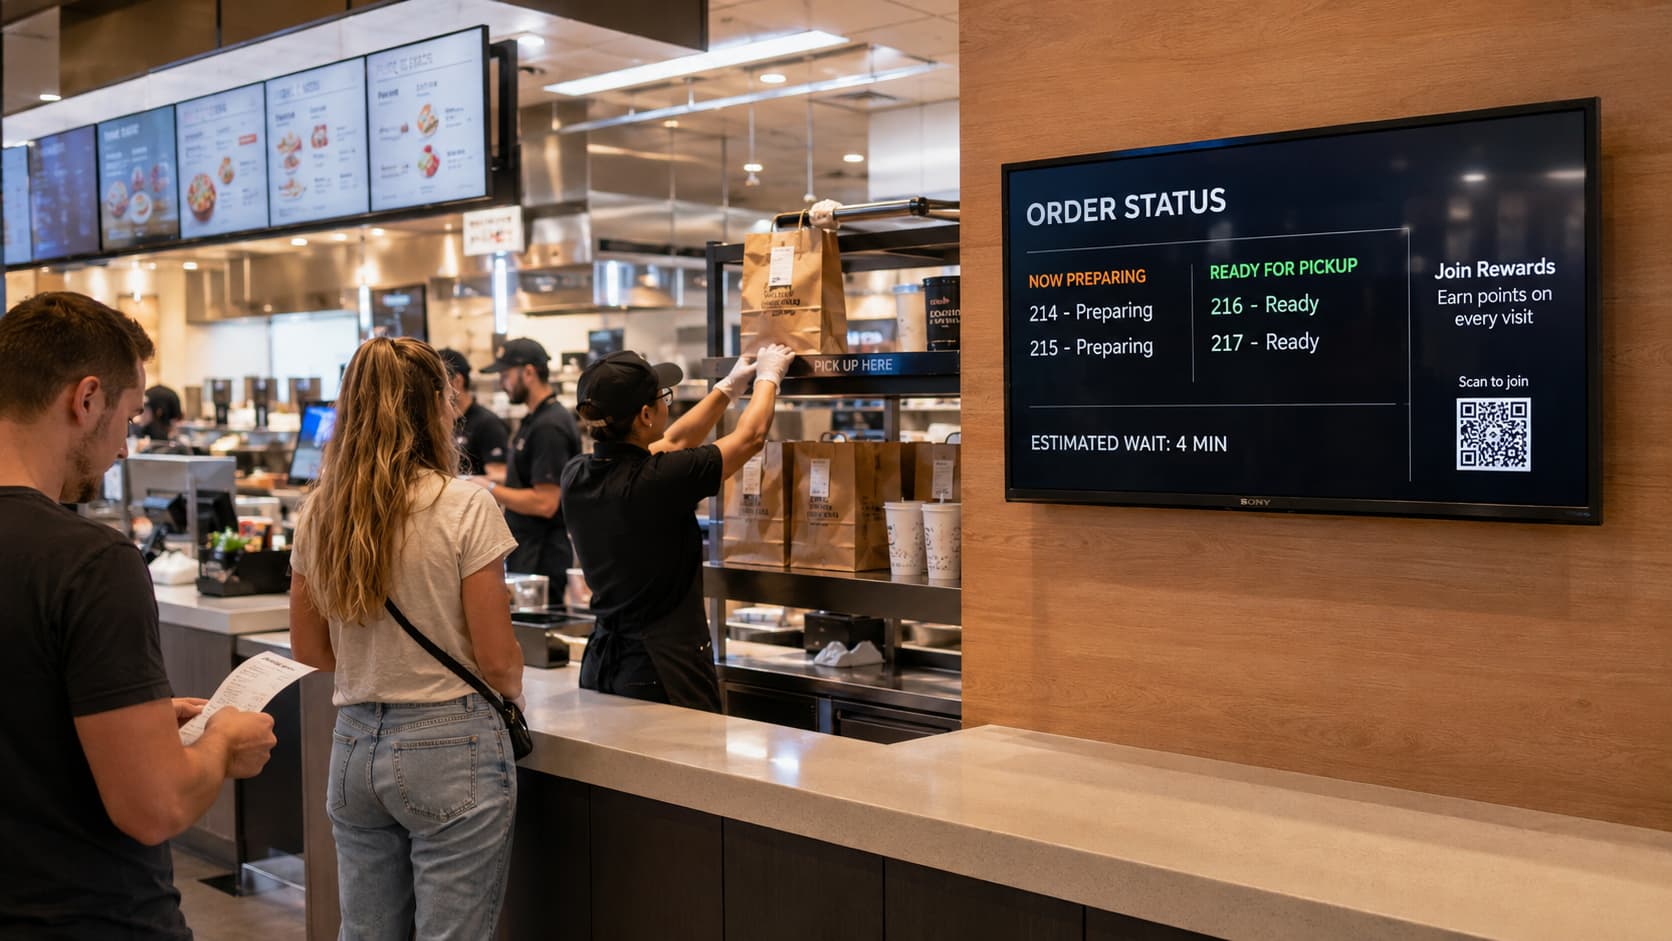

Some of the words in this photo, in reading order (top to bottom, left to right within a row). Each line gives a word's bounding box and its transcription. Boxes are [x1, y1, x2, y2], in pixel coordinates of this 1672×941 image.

[1027, 197, 1117, 226] ORDER
[1125, 188, 1226, 218] STATUS
[1030, 274, 1063, 288] NOW
[1067, 269, 1146, 286] PREPARING
[1211, 263, 1259, 279] READY
[1265, 261, 1294, 276] FOR
[1300, 258, 1357, 275] PICKUP
[1435, 262, 1471, 279] Join
[1477, 257, 1555, 277] Rewards
[1211, 297, 1242, 315] 216
[1266, 294, 1319, 316] Ready
[1438, 290, 1472, 304] Earn
[1478, 286, 1527, 307] points
[1532, 289, 1552, 301] on
[1030, 305, 1057, 321] 214
[1077, 302, 1152, 323] Preparing
[1455, 314, 1497, 329] every
[1502, 309, 1533, 324] visit
[1031, 340, 1058, 356] 215
[1077, 337, 1153, 358] Preparing
[1212, 334, 1243, 351] 217
[1267, 332, 1319, 353] Ready
[814, 359, 840, 373] PICK
[843, 359, 859, 372] UP
[862, 358, 893, 372] HERE
[1459, 376, 1487, 387] Scan
[1491, 376, 1503, 387] to
[1505, 375, 1528, 390] join
[1032, 435, 1118, 450] ESTIMATED
[1124, 436, 1170, 451] WAIT:
[1175, 436, 1187, 451] 4
[1194, 436, 1226, 451] MIN
